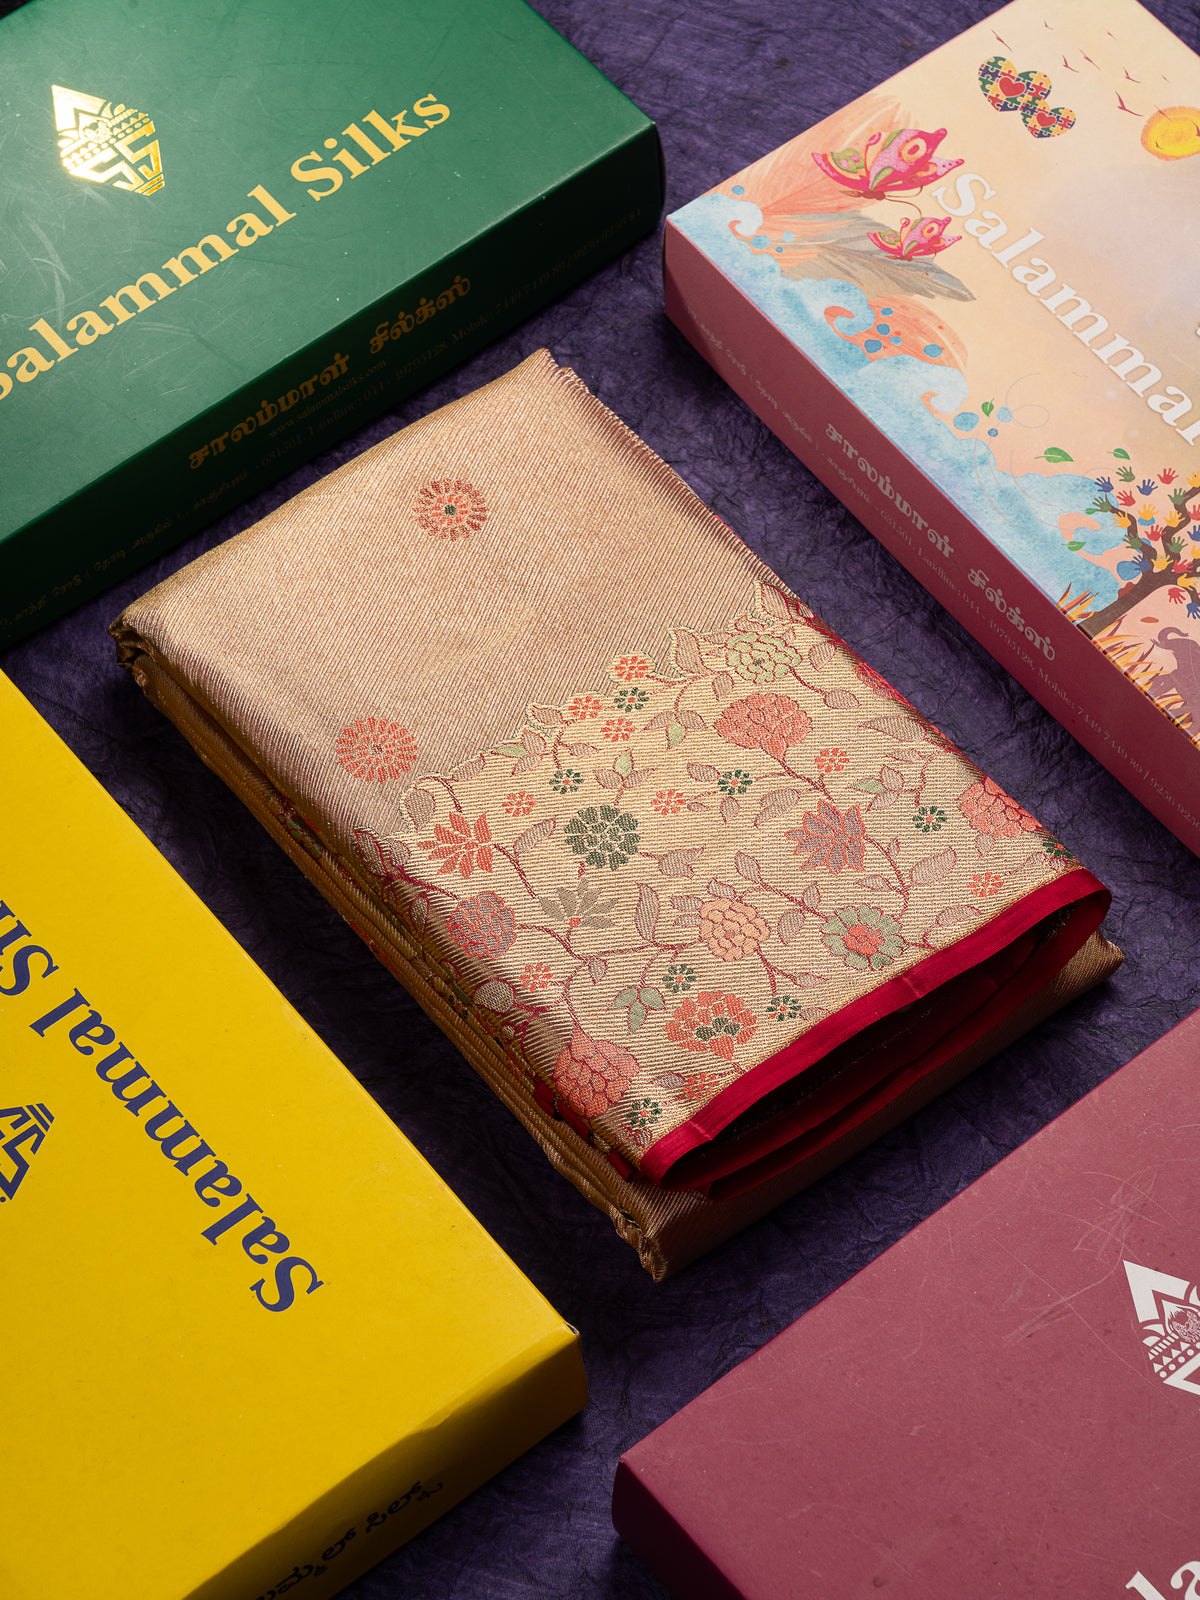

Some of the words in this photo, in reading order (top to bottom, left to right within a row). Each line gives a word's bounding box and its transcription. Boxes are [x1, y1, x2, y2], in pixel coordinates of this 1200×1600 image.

[0, 185, 296, 400] alammal
[291, 94, 450, 201] Silks
[189, 352, 349, 469] சாலம்மாள்
[368, 275, 471, 354] சில்க்ஸ்
[826, 423, 954, 558] சாலம்மாள்
[968, 569, 1055, 661] சில்க்ஸ்
[30, 988, 323, 1312] Salammal
